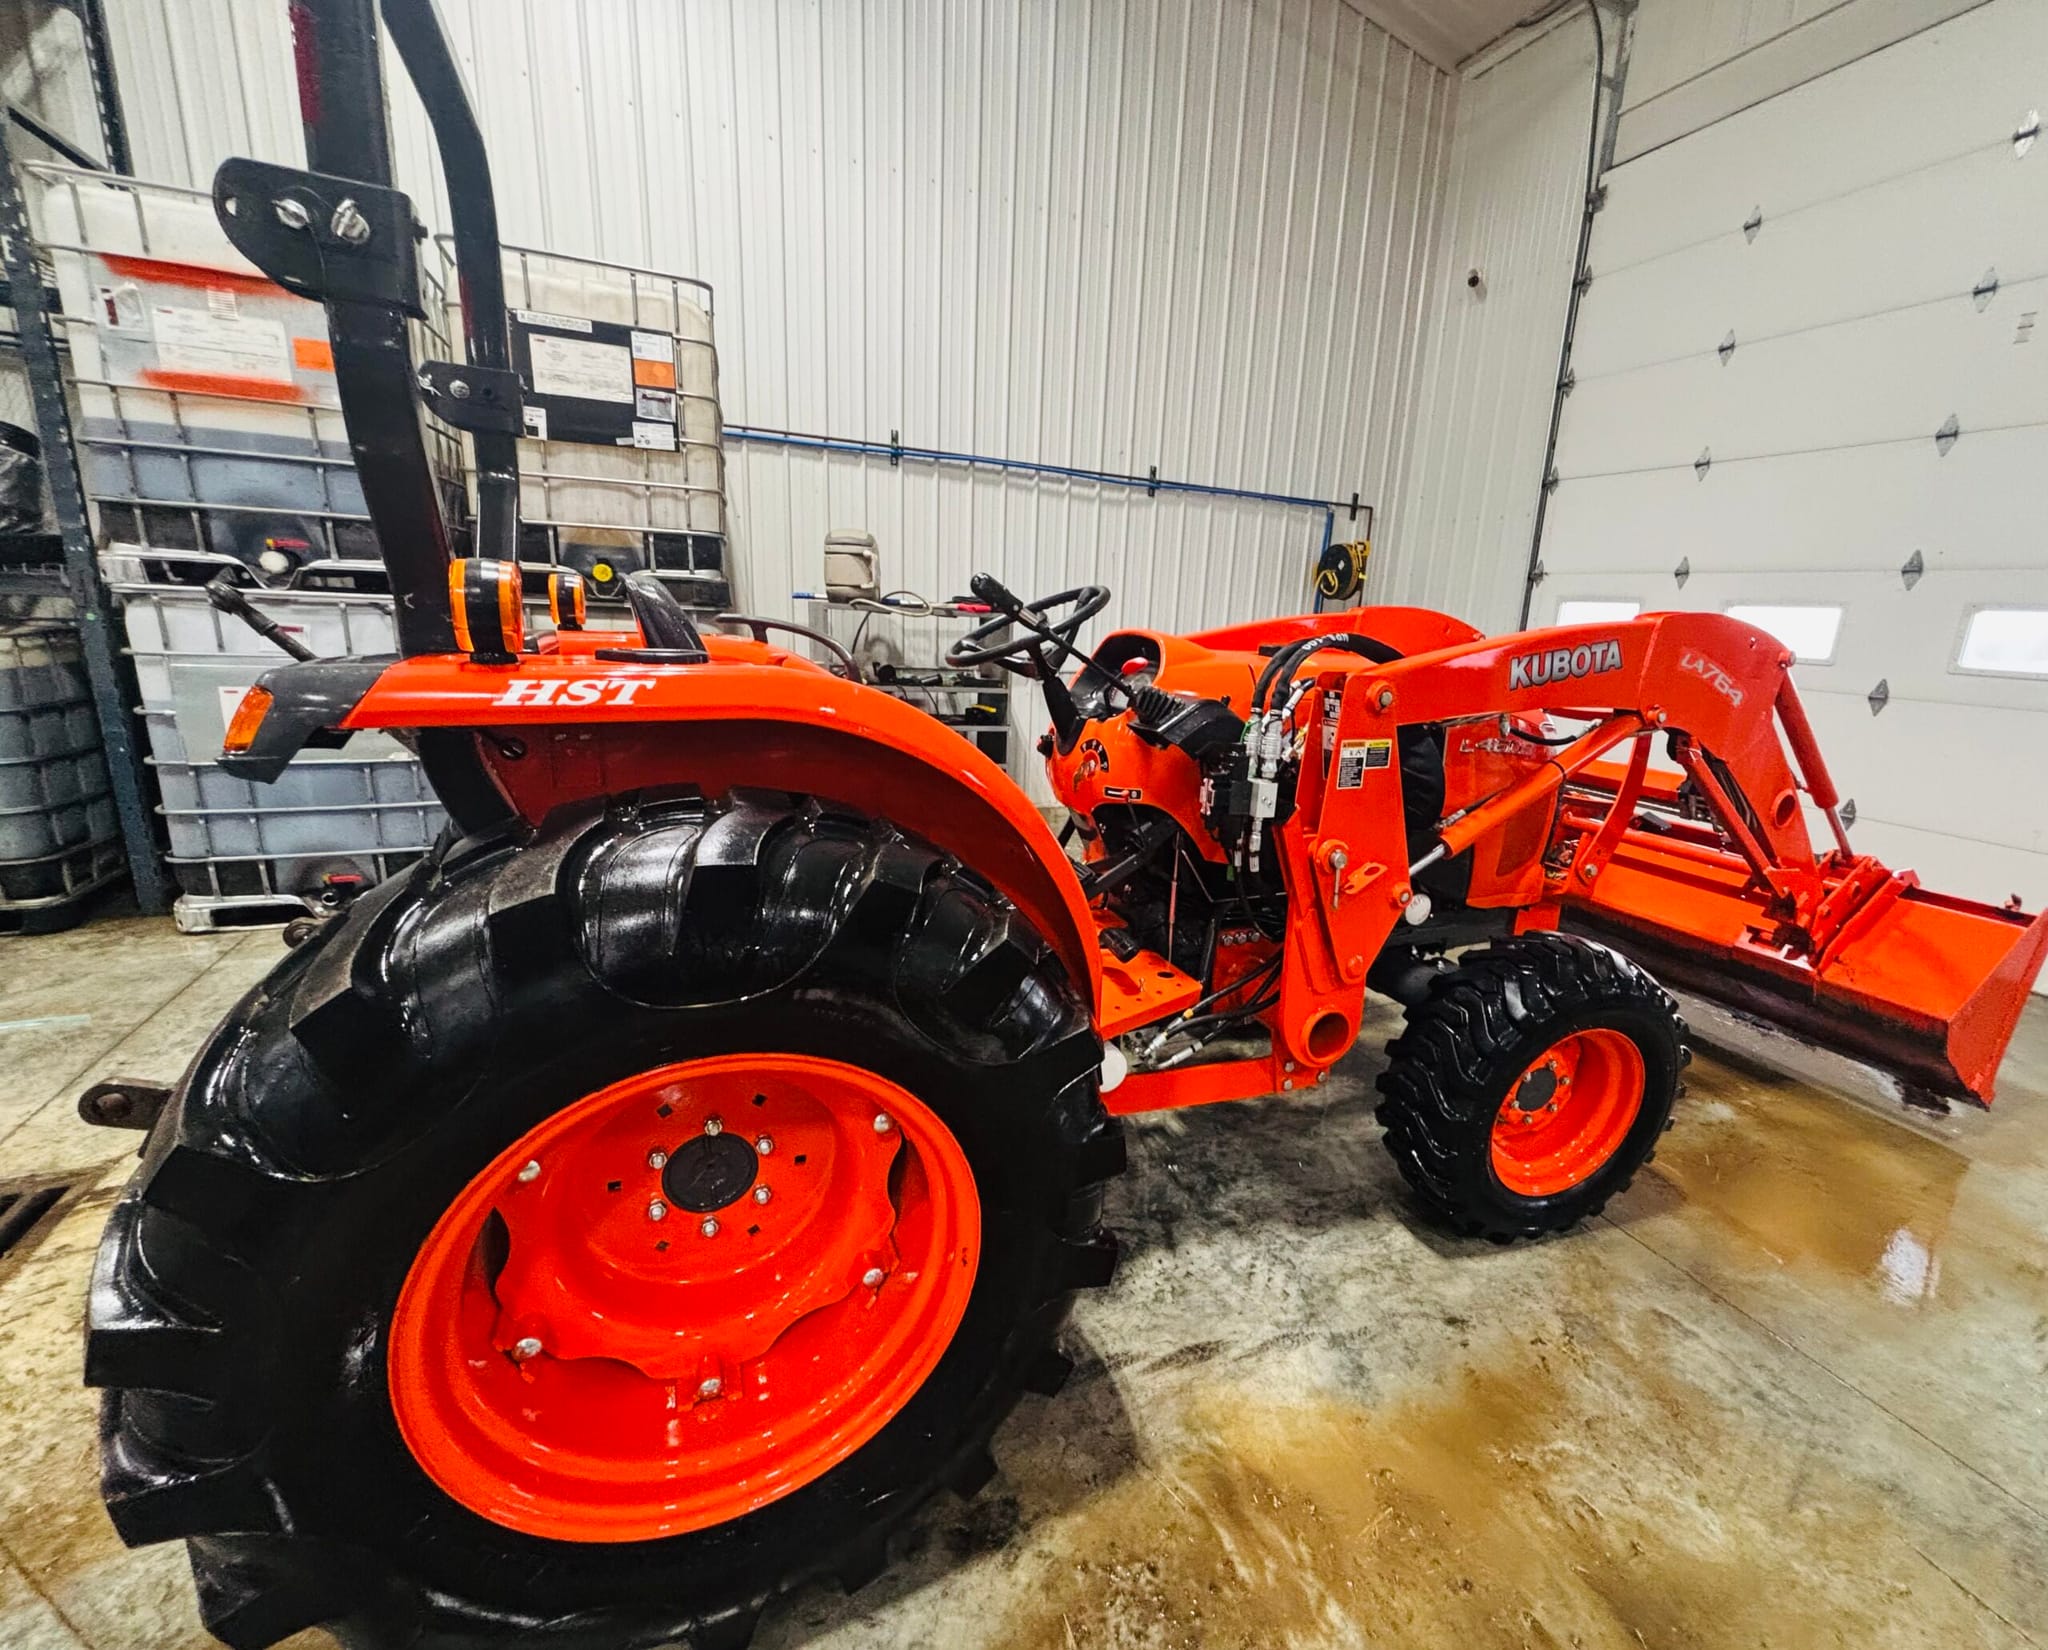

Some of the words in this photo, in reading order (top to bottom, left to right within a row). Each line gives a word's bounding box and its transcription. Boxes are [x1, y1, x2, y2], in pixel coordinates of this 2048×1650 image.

[1509, 639, 1622, 691] KUBOTA
[1681, 653, 1743, 708] LA764
[491, 679, 657, 706] HST
